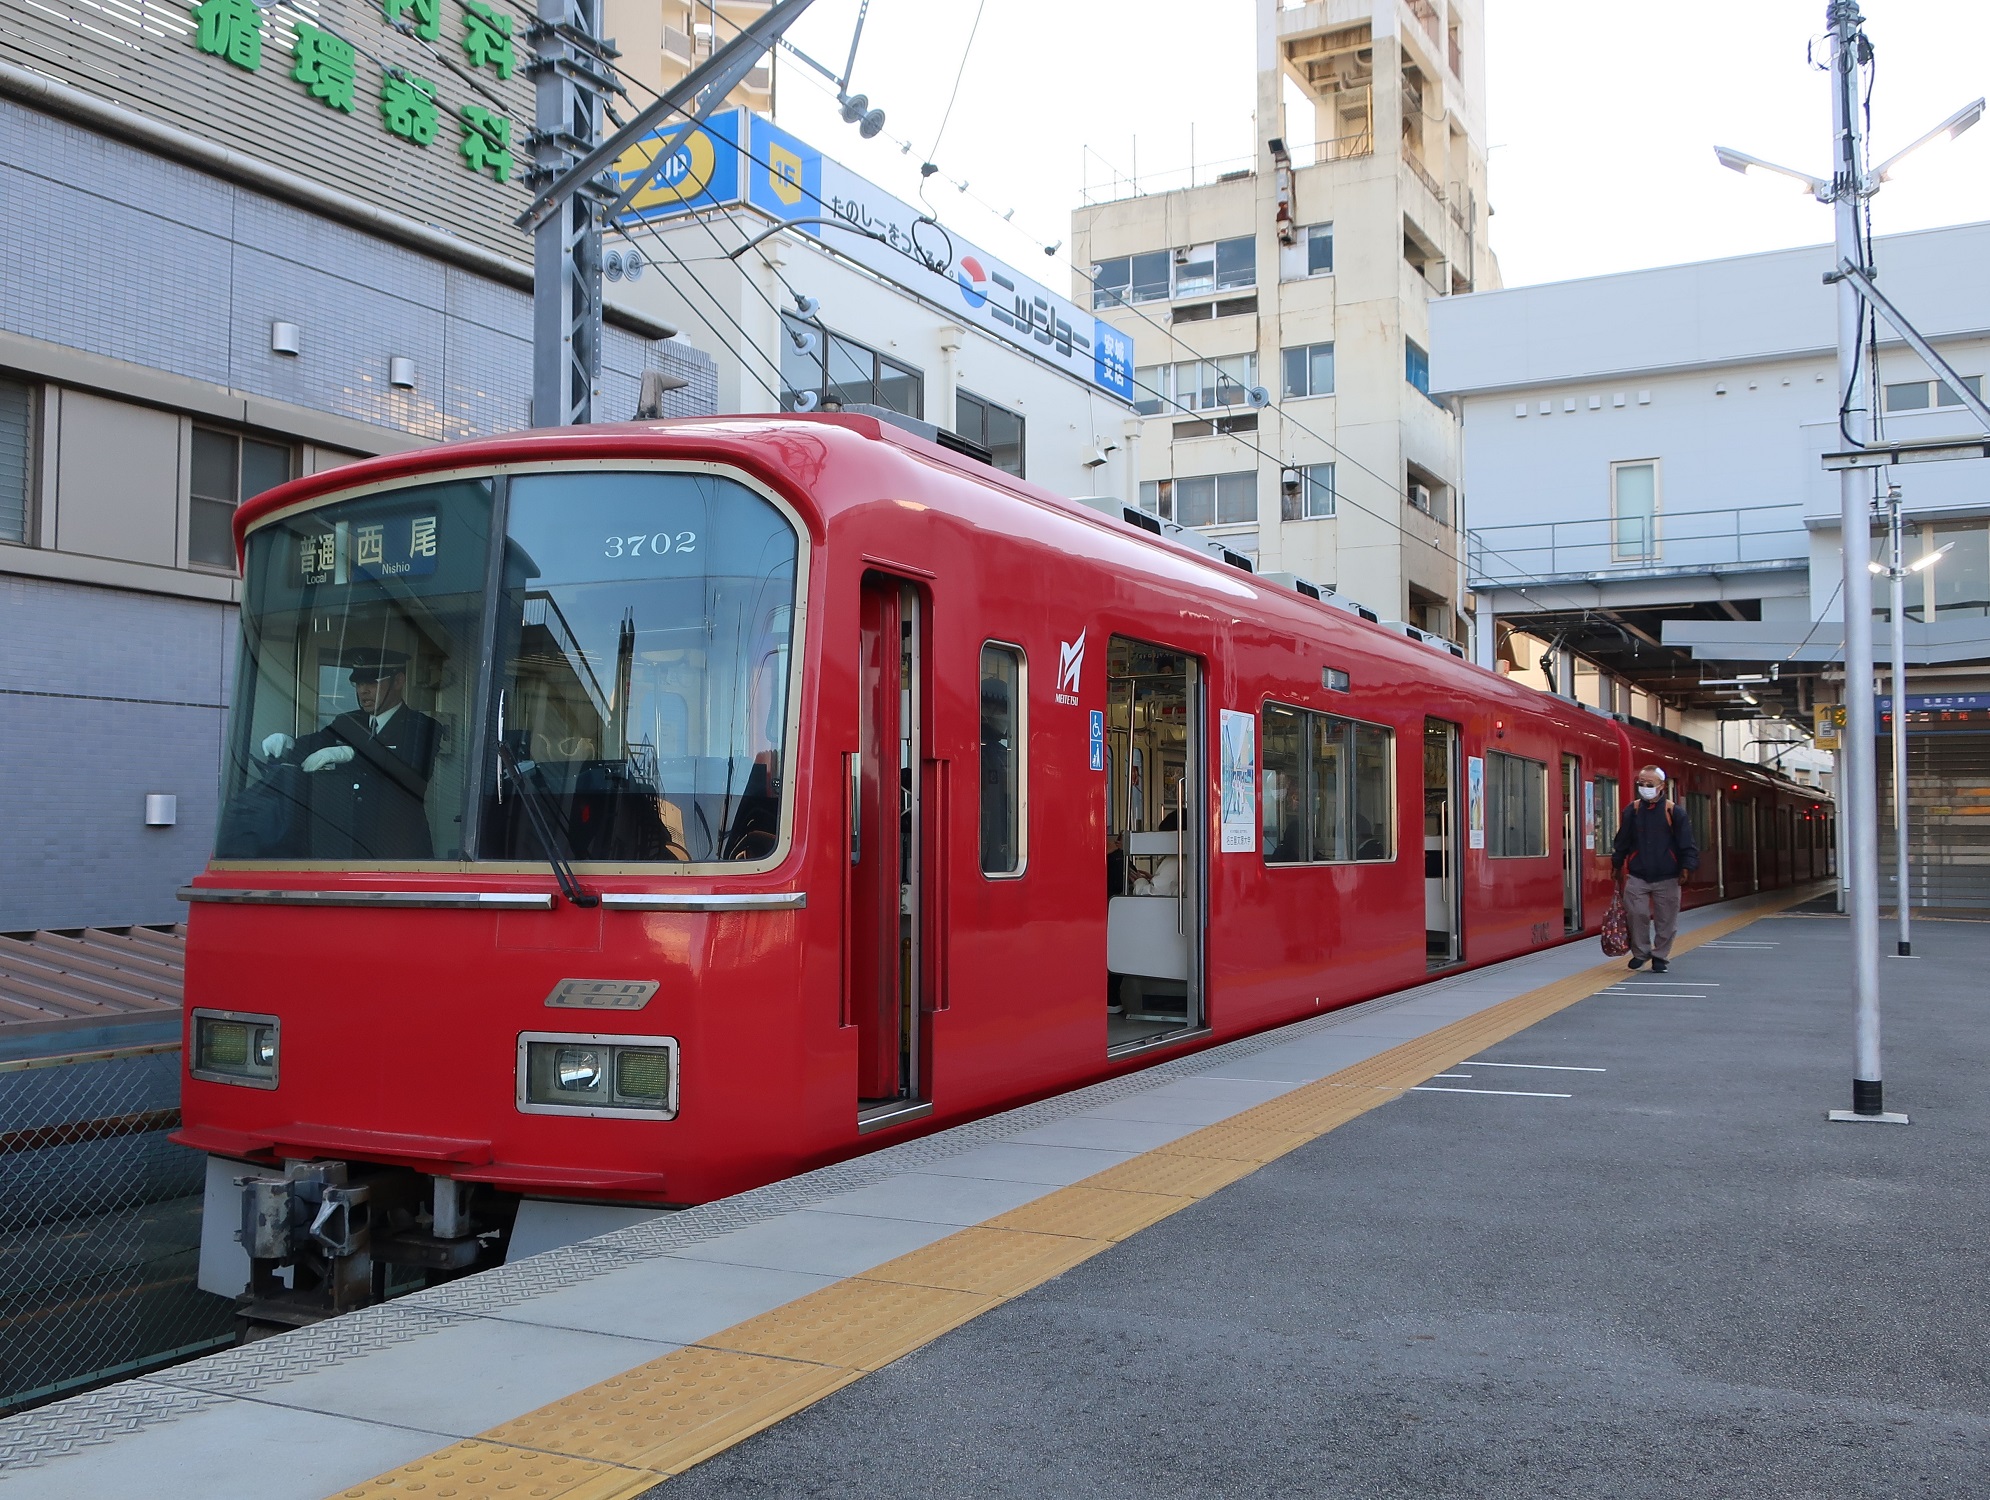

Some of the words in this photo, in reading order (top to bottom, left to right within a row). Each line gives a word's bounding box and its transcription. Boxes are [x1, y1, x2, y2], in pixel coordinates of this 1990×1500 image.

[191, 0, 515, 183] 循環器科
[775, 160, 796, 188] 1F
[991, 270, 1091, 358] ニッショー
[1104, 333, 1125, 364] 安城
[1103, 357, 1125, 387] 支店
[300, 533, 335, 574] 普通
[357, 516, 437, 567] 西尾
[604, 531, 696, 558] 3702
[306, 573, 327, 585] Local
[382, 561, 410, 575] Nishio
[1055, 692, 1079, 706] MEITETSU
